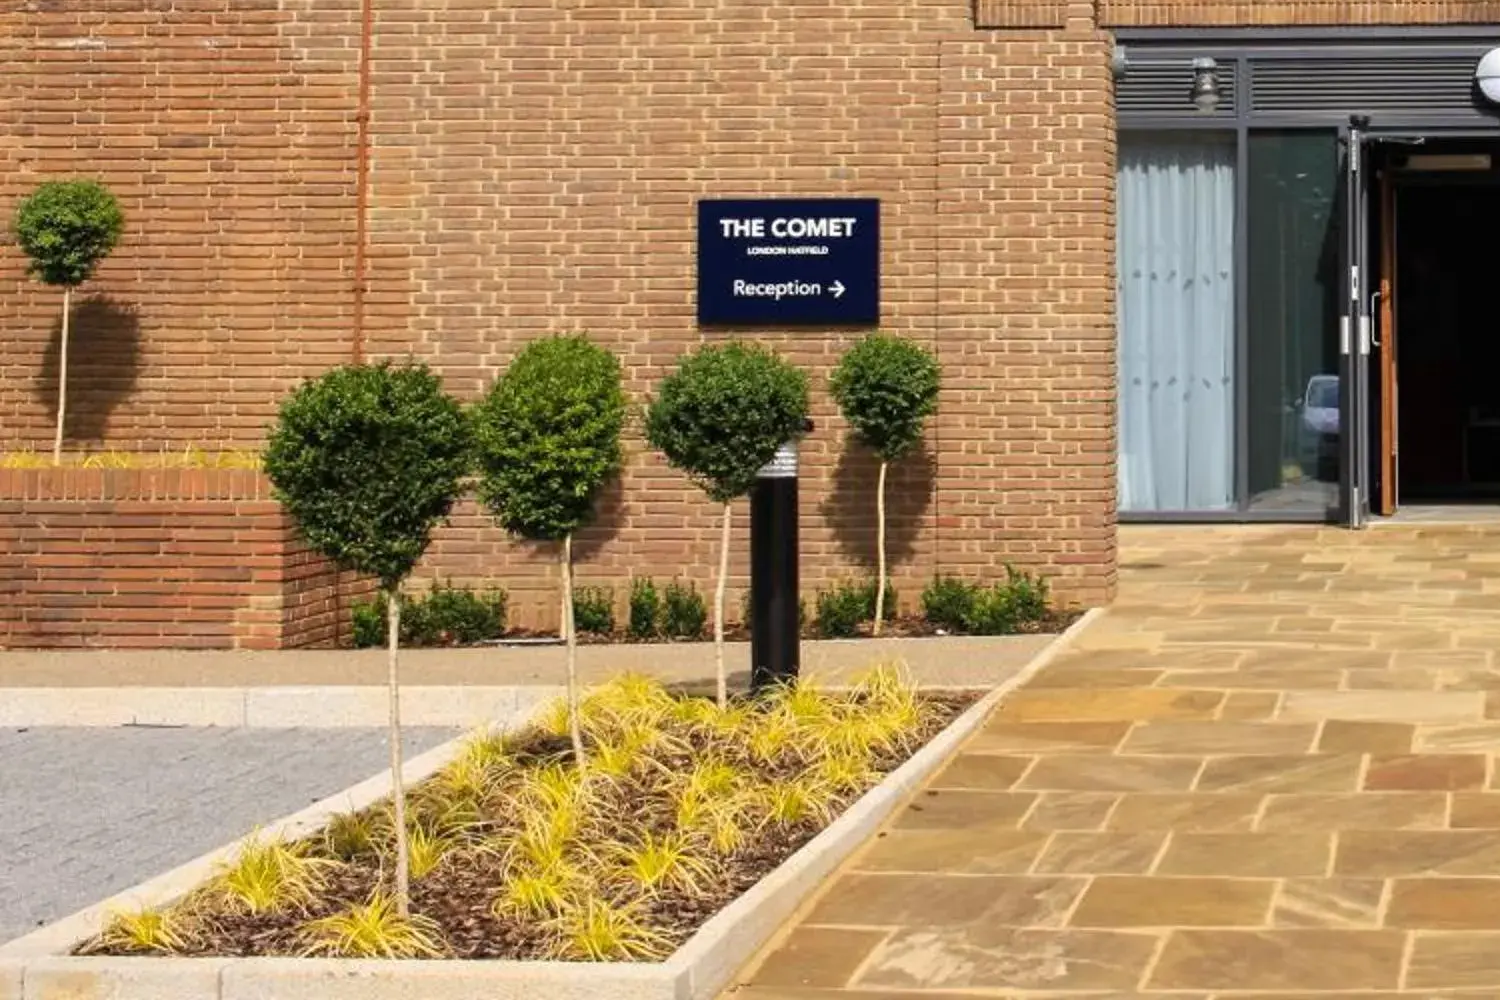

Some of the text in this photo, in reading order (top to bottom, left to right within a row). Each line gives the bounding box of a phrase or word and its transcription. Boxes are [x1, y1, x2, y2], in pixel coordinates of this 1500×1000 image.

[720, 217, 857, 238] THE COMET
[747, 246, 786, 255] LONDON
[733, 279, 821, 300] Reception
